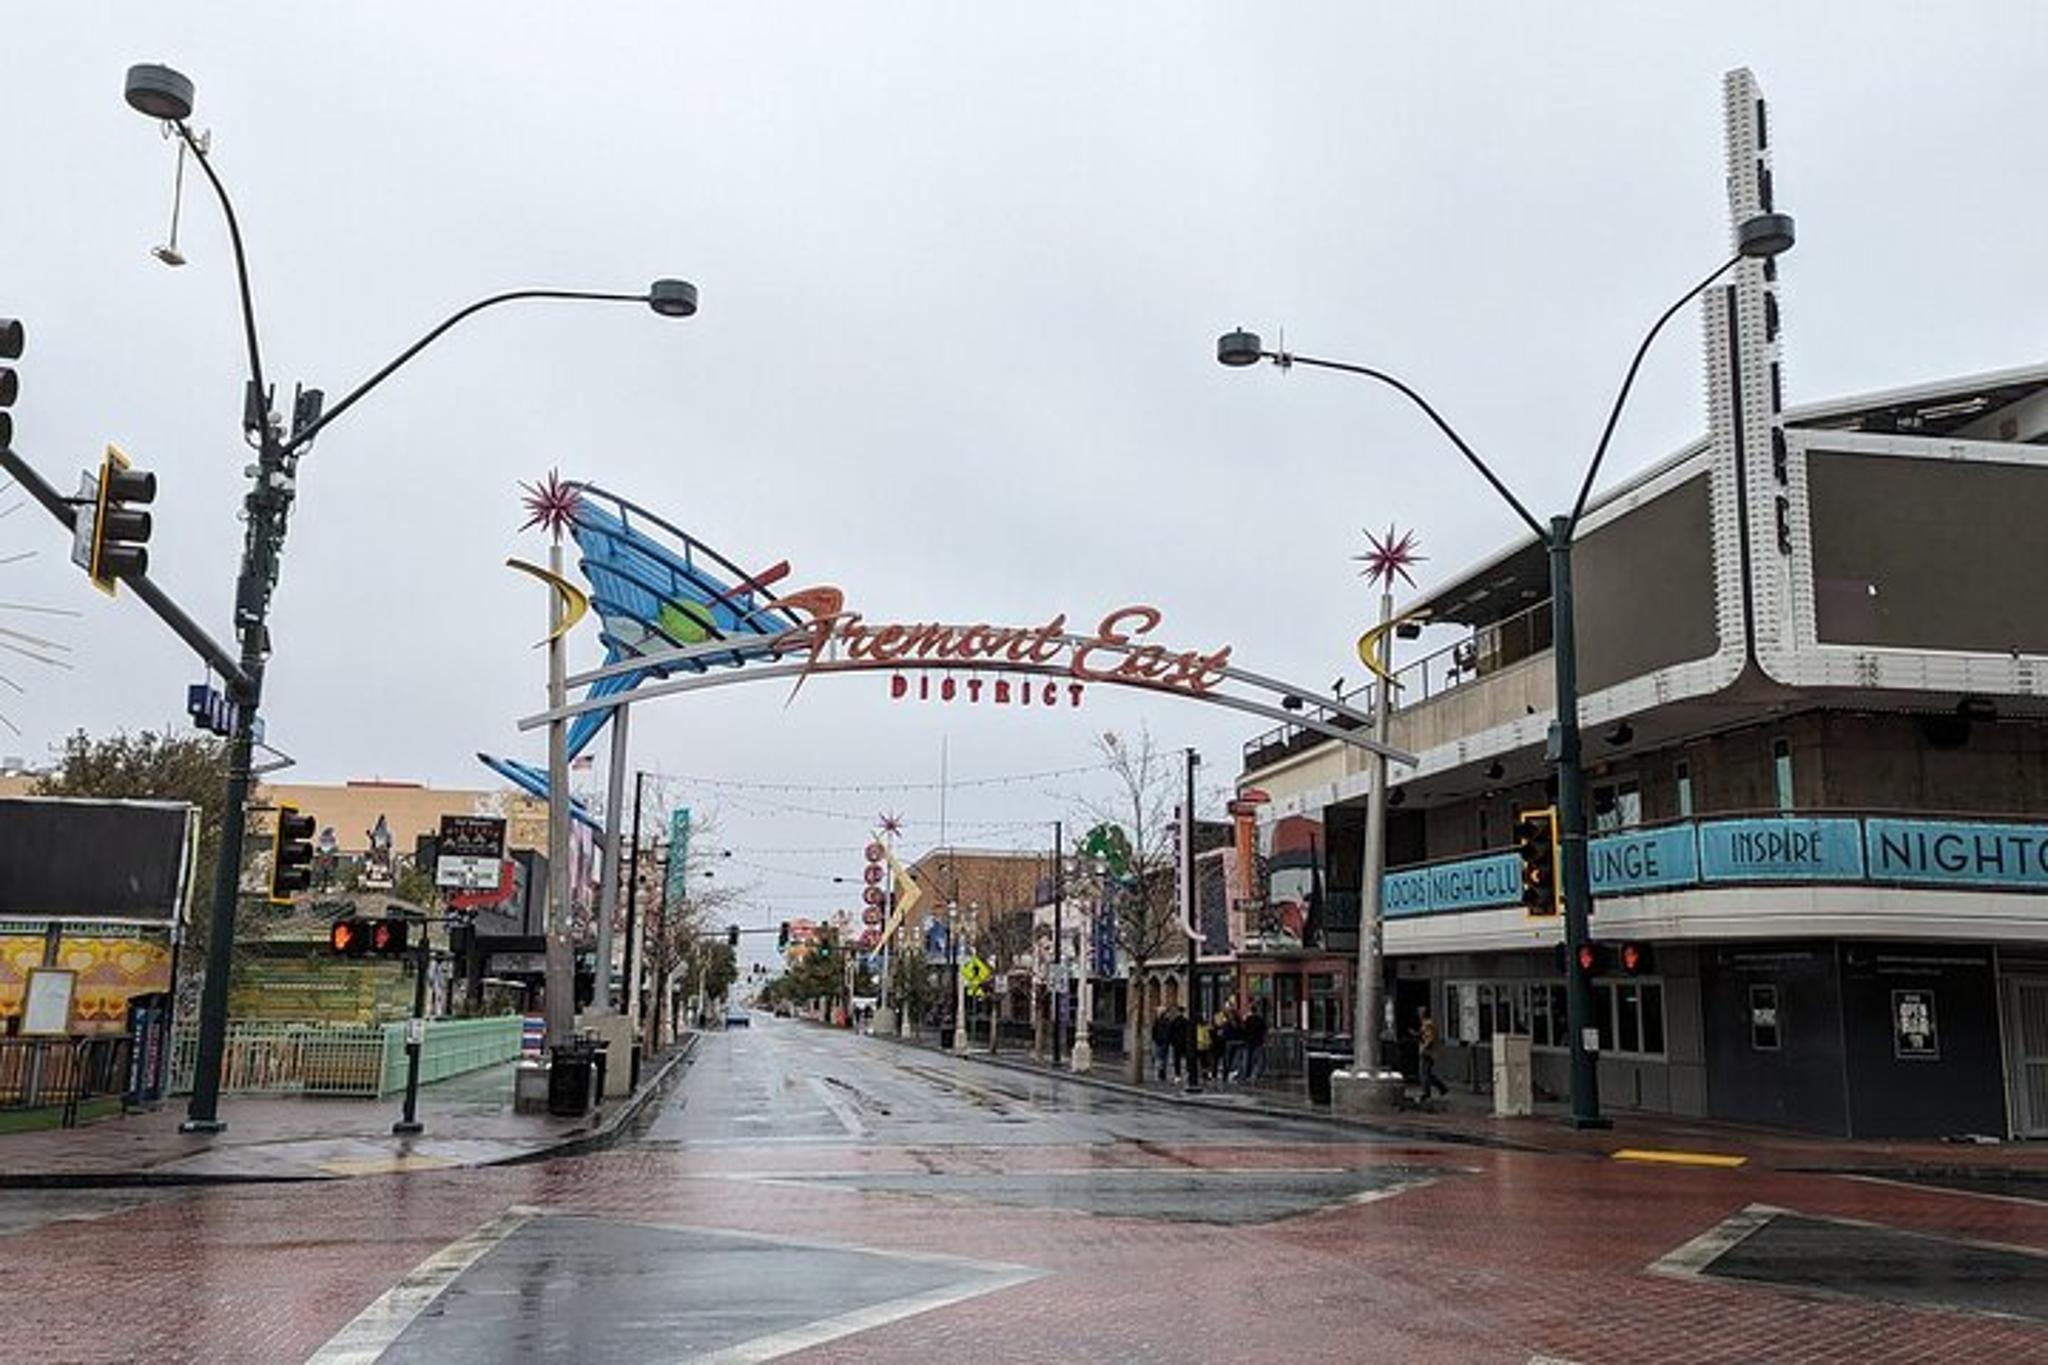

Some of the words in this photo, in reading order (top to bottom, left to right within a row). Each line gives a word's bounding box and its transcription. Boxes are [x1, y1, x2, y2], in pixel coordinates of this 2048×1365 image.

[758, 586, 1066, 708] Fremont
[1071, 606, 1232, 690] East
[890, 675, 1084, 706] DISTRICT
[1591, 842, 1660, 883] UNGE
[1731, 828, 1823, 864] INSPIRE
[1880, 833, 2048, 875] NIGHT
[1386, 877, 1425, 908] OORS
[1433, 862, 1518, 900] NIGHTCLU
